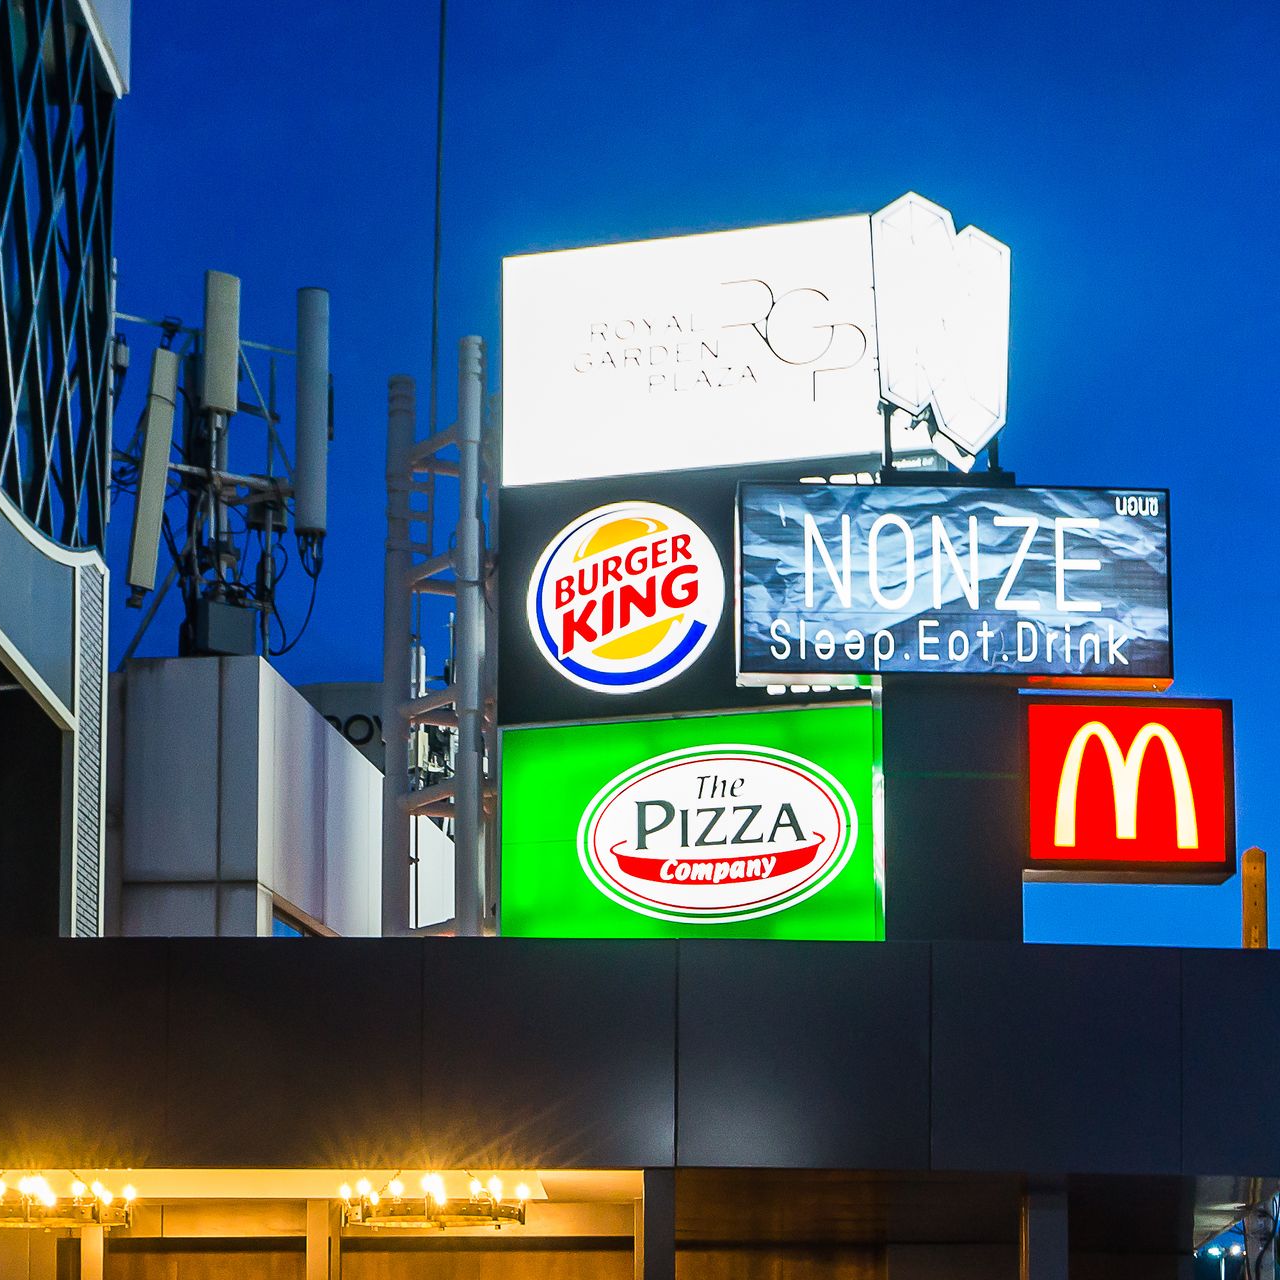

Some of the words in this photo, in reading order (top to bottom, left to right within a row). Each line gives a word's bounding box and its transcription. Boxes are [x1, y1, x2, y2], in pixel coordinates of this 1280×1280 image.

[590, 313, 705, 343] ROYAL
[573, 339, 719, 374] GARDEN
[648, 365, 757, 393] PLAZA
[555, 533, 693, 610] BURGER
[803, 513, 1103, 612] NONZE
[562, 564, 699, 655] KING
[696, 774, 745, 800] The
[634, 799, 808, 850] PIZZA
[659, 855, 777, 883] Company
